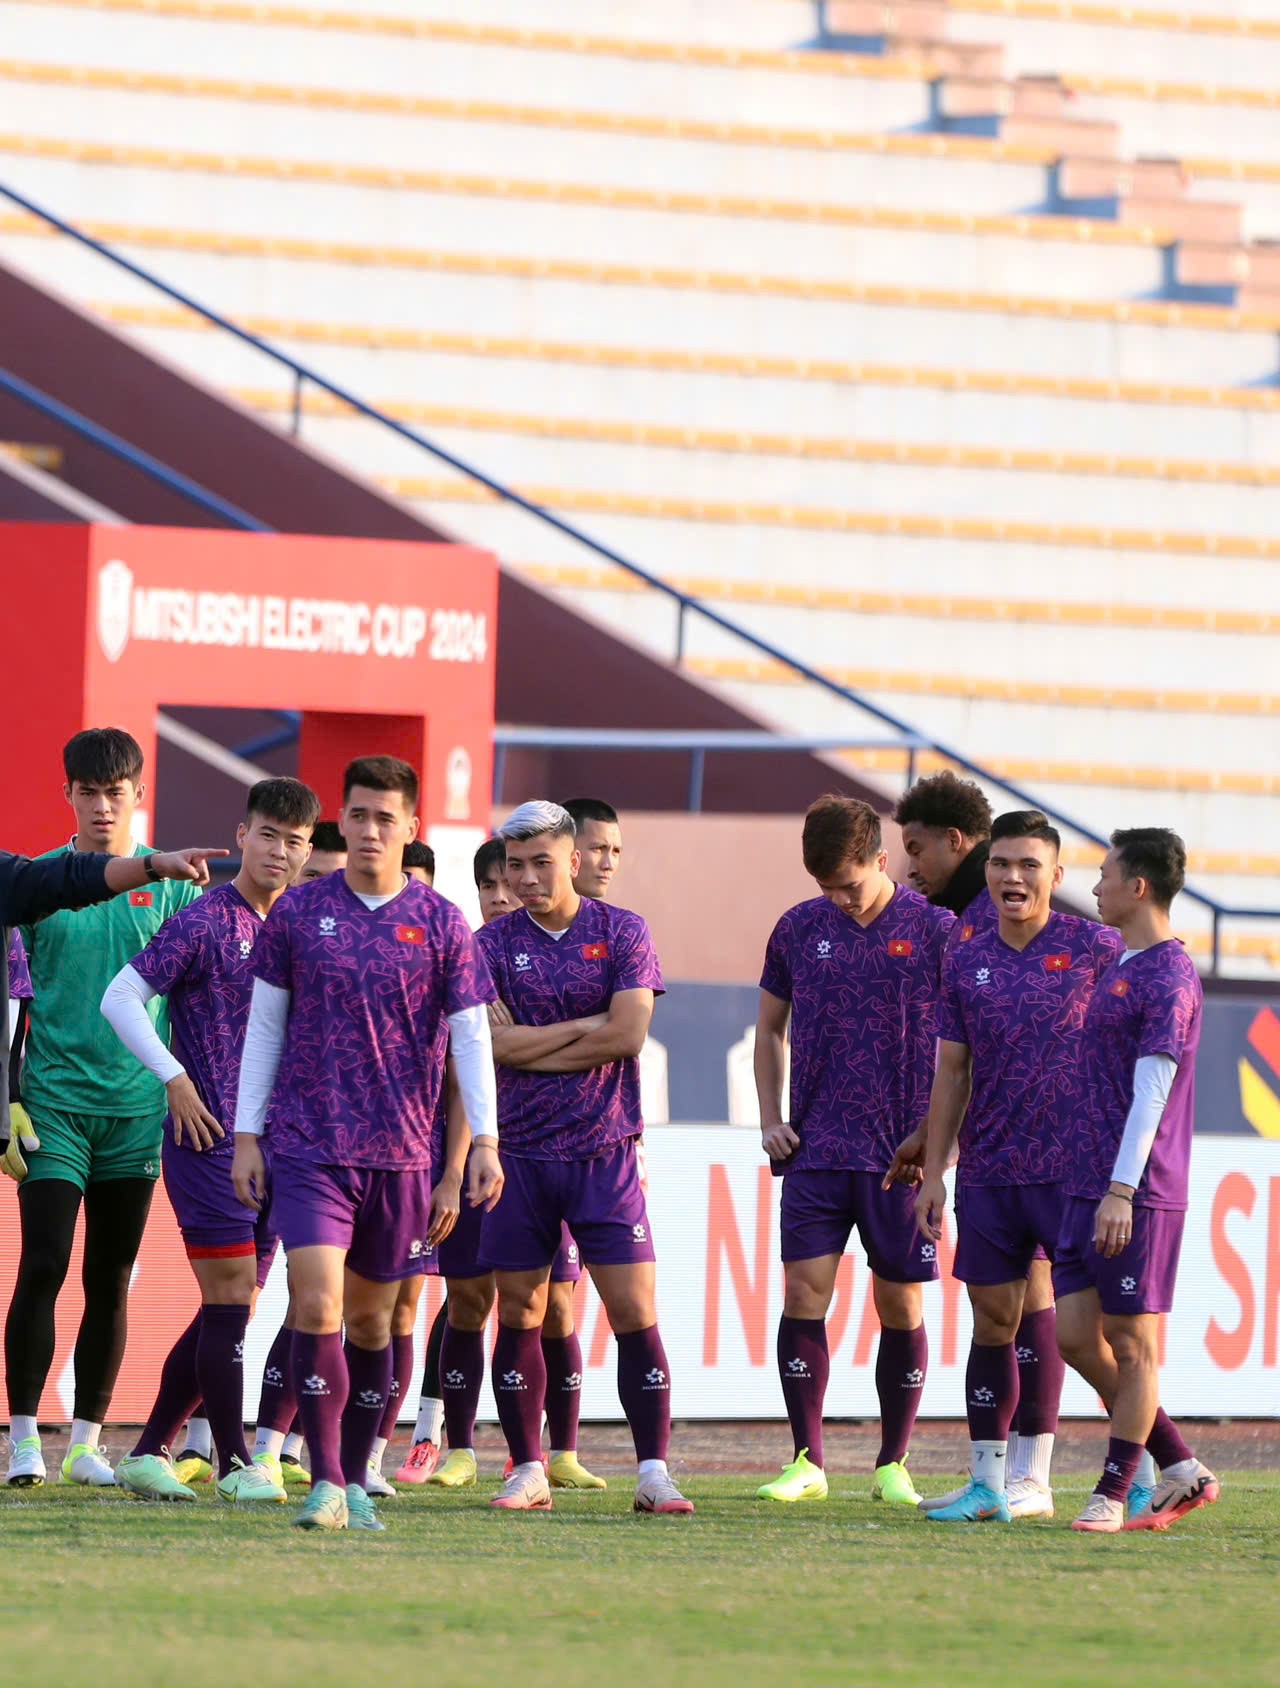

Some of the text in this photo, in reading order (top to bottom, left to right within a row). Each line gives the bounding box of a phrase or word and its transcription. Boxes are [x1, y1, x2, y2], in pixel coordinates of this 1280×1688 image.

[263, 595, 370, 657] ELECTRIC
[372, 603, 427, 658] CUP
[429, 607, 487, 664] 2024
[975, 1450, 985, 1461] 7
